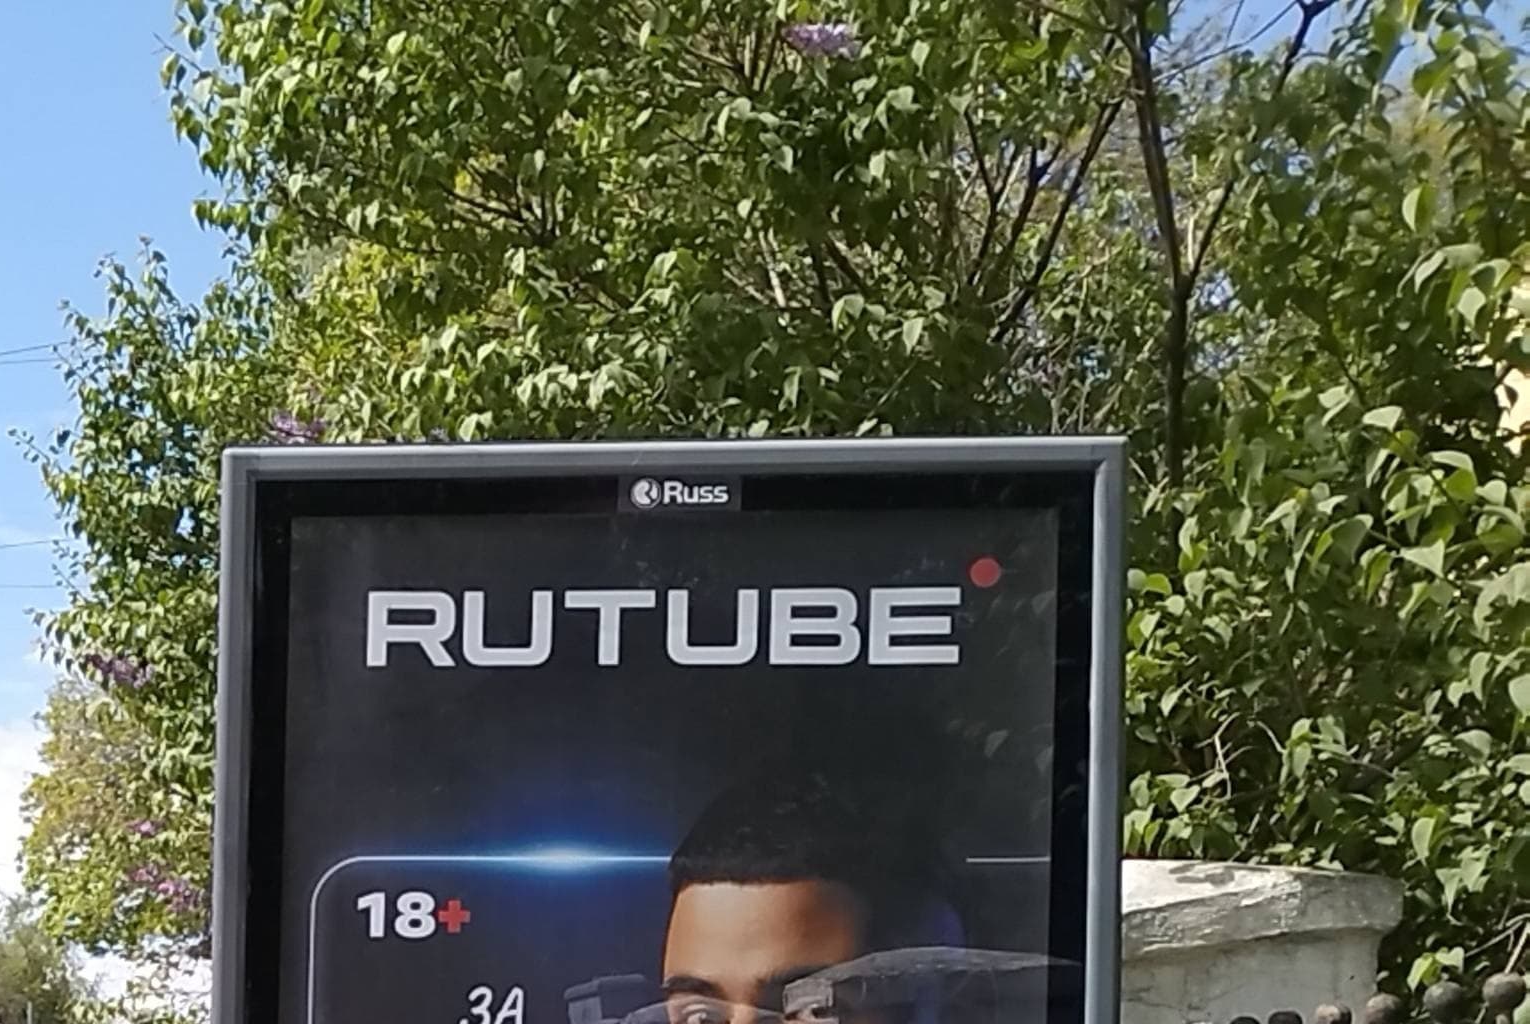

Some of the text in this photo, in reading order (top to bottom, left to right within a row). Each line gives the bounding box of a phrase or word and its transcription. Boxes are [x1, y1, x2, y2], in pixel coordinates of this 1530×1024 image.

[662, 480, 729, 505] Russ
[366, 586, 962, 668] RUTUBE
[356, 889, 471, 938] 18+
